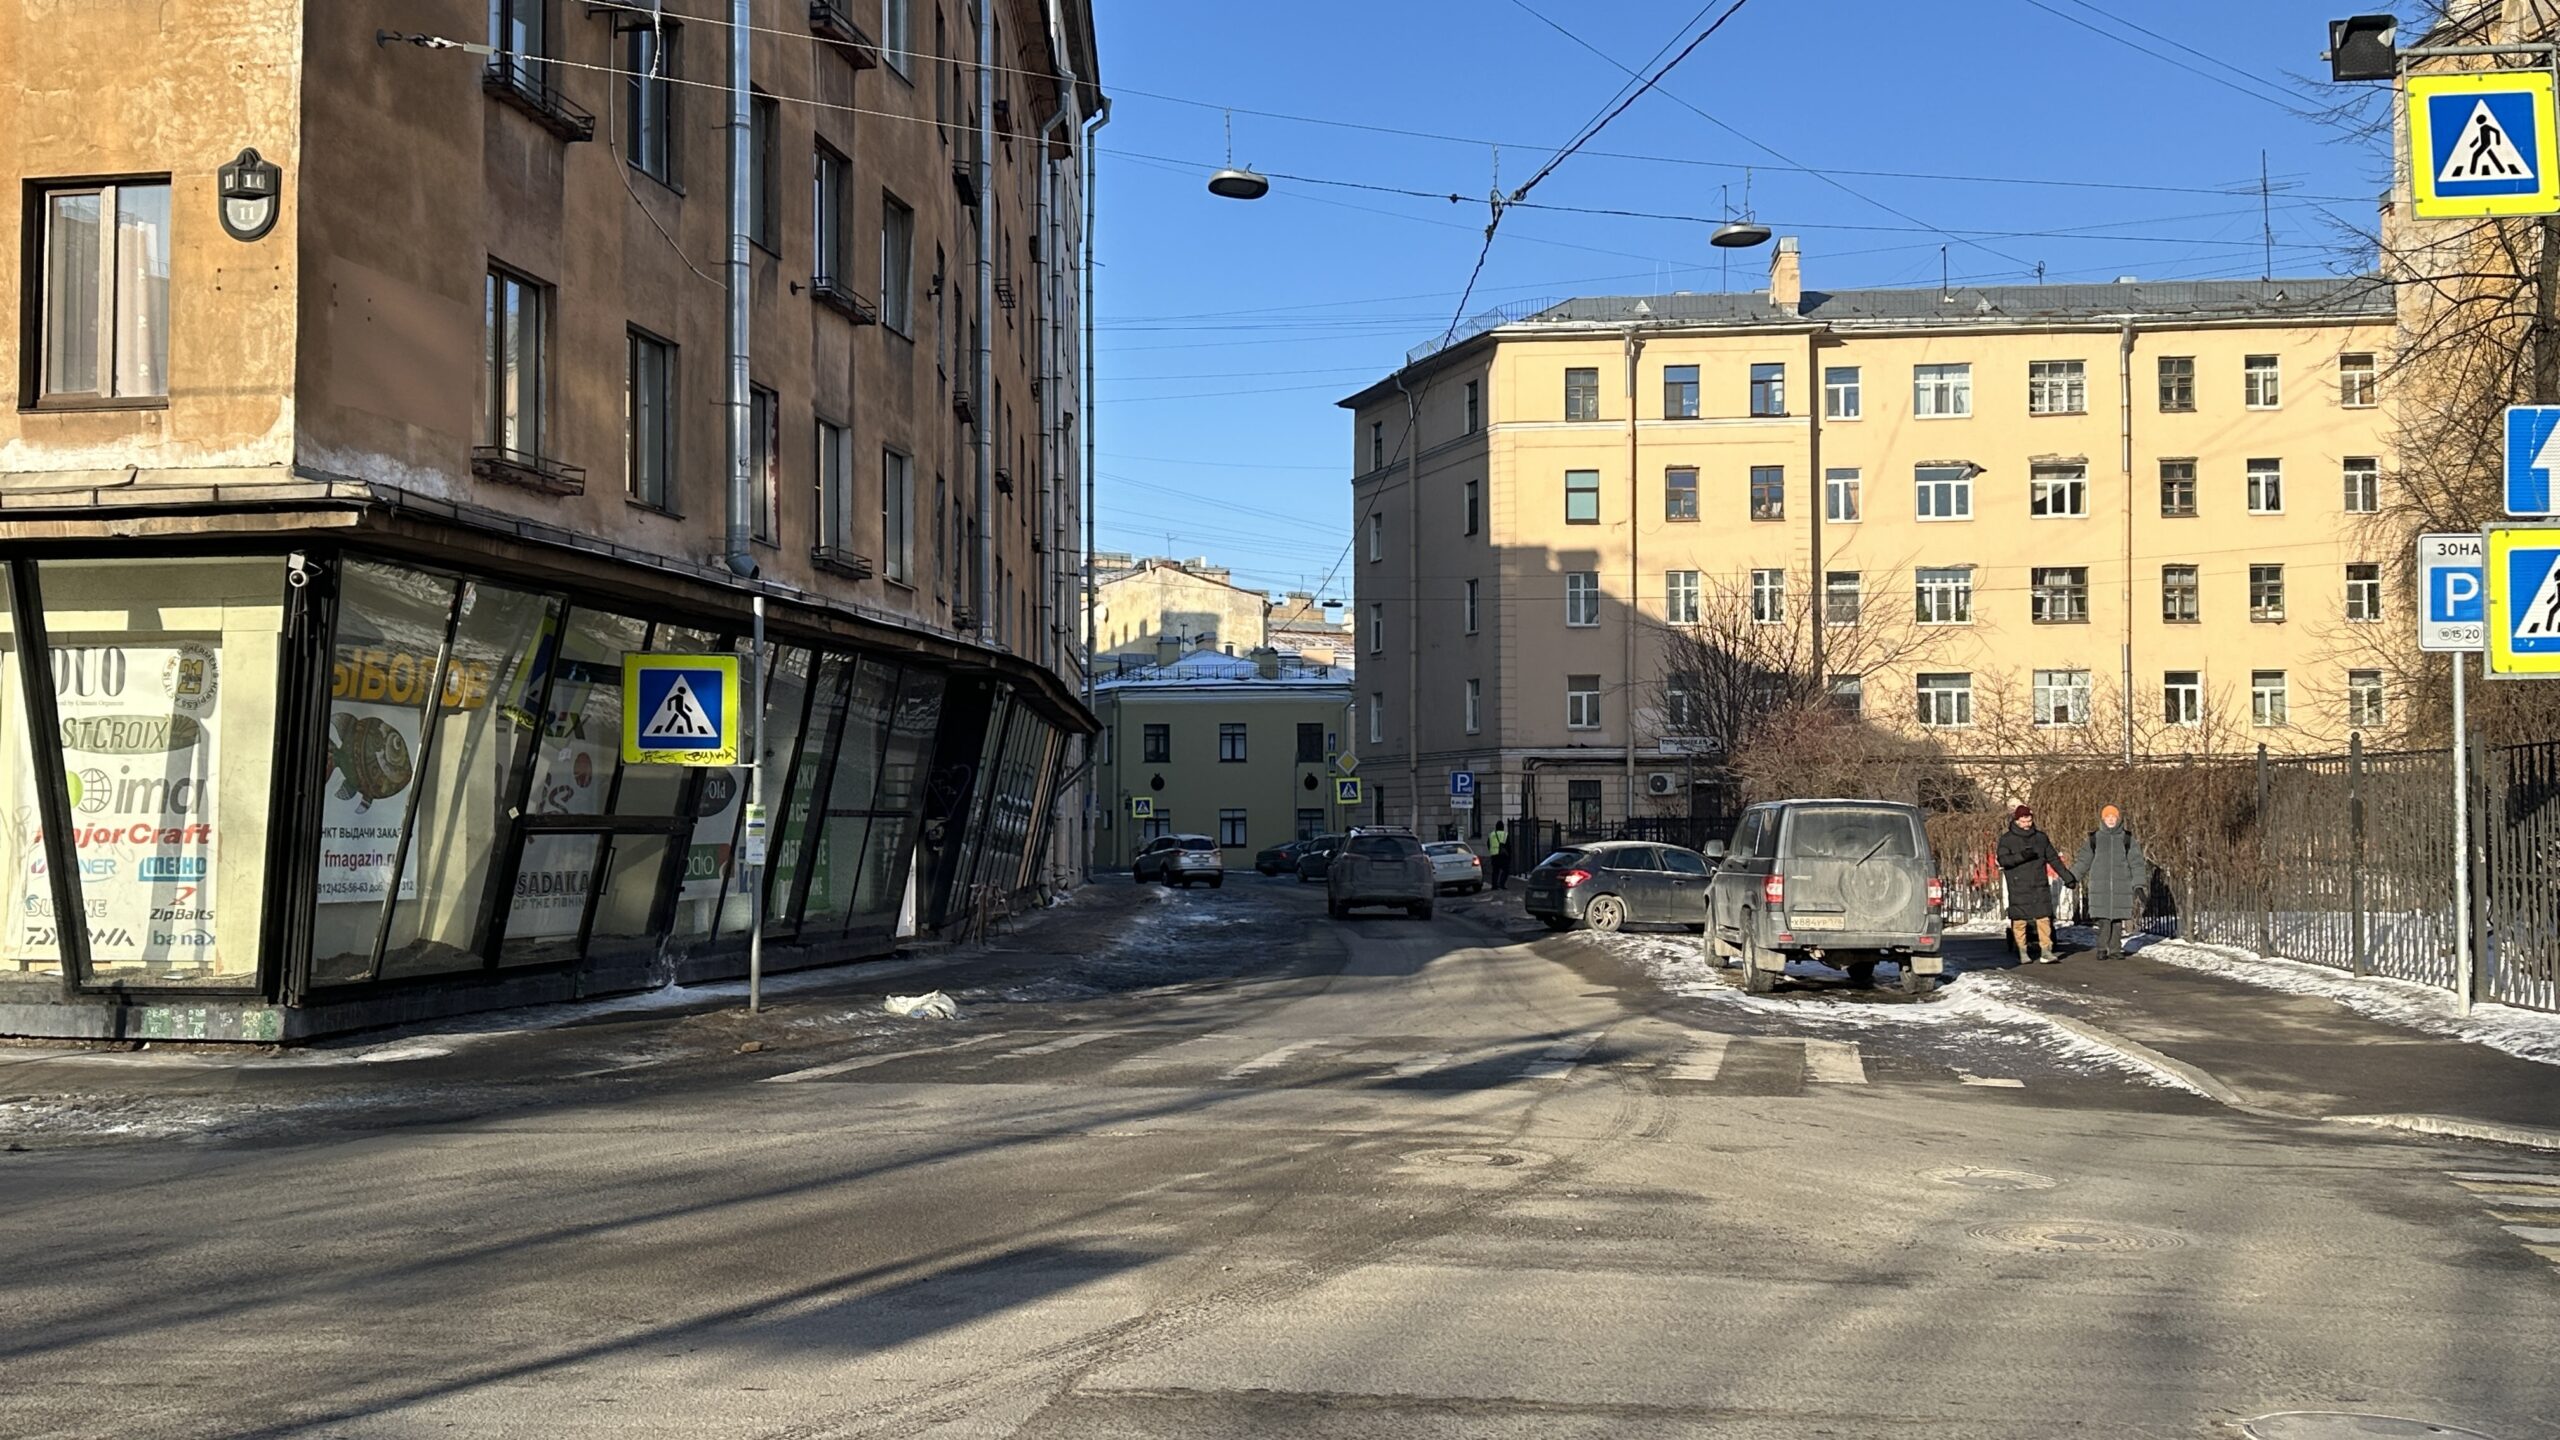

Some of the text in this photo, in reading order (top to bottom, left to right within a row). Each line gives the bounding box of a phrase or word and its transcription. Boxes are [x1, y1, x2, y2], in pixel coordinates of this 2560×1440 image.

[240, 205, 255, 221] 11
[2438, 543, 2482, 556] ЗОНА
[2446, 572, 2479, 617] P
[2452, 629, 2462, 639] 15
[2465, 628, 2480, 640] 20
[49, 646, 126, 697] DUO
[333, 649, 488, 708] ЫБОЛОВ
[1457, 774, 1470, 792] P
[321, 827, 337, 839] НКТ
[339, 827, 375, 840] ВЫДАЧИ
